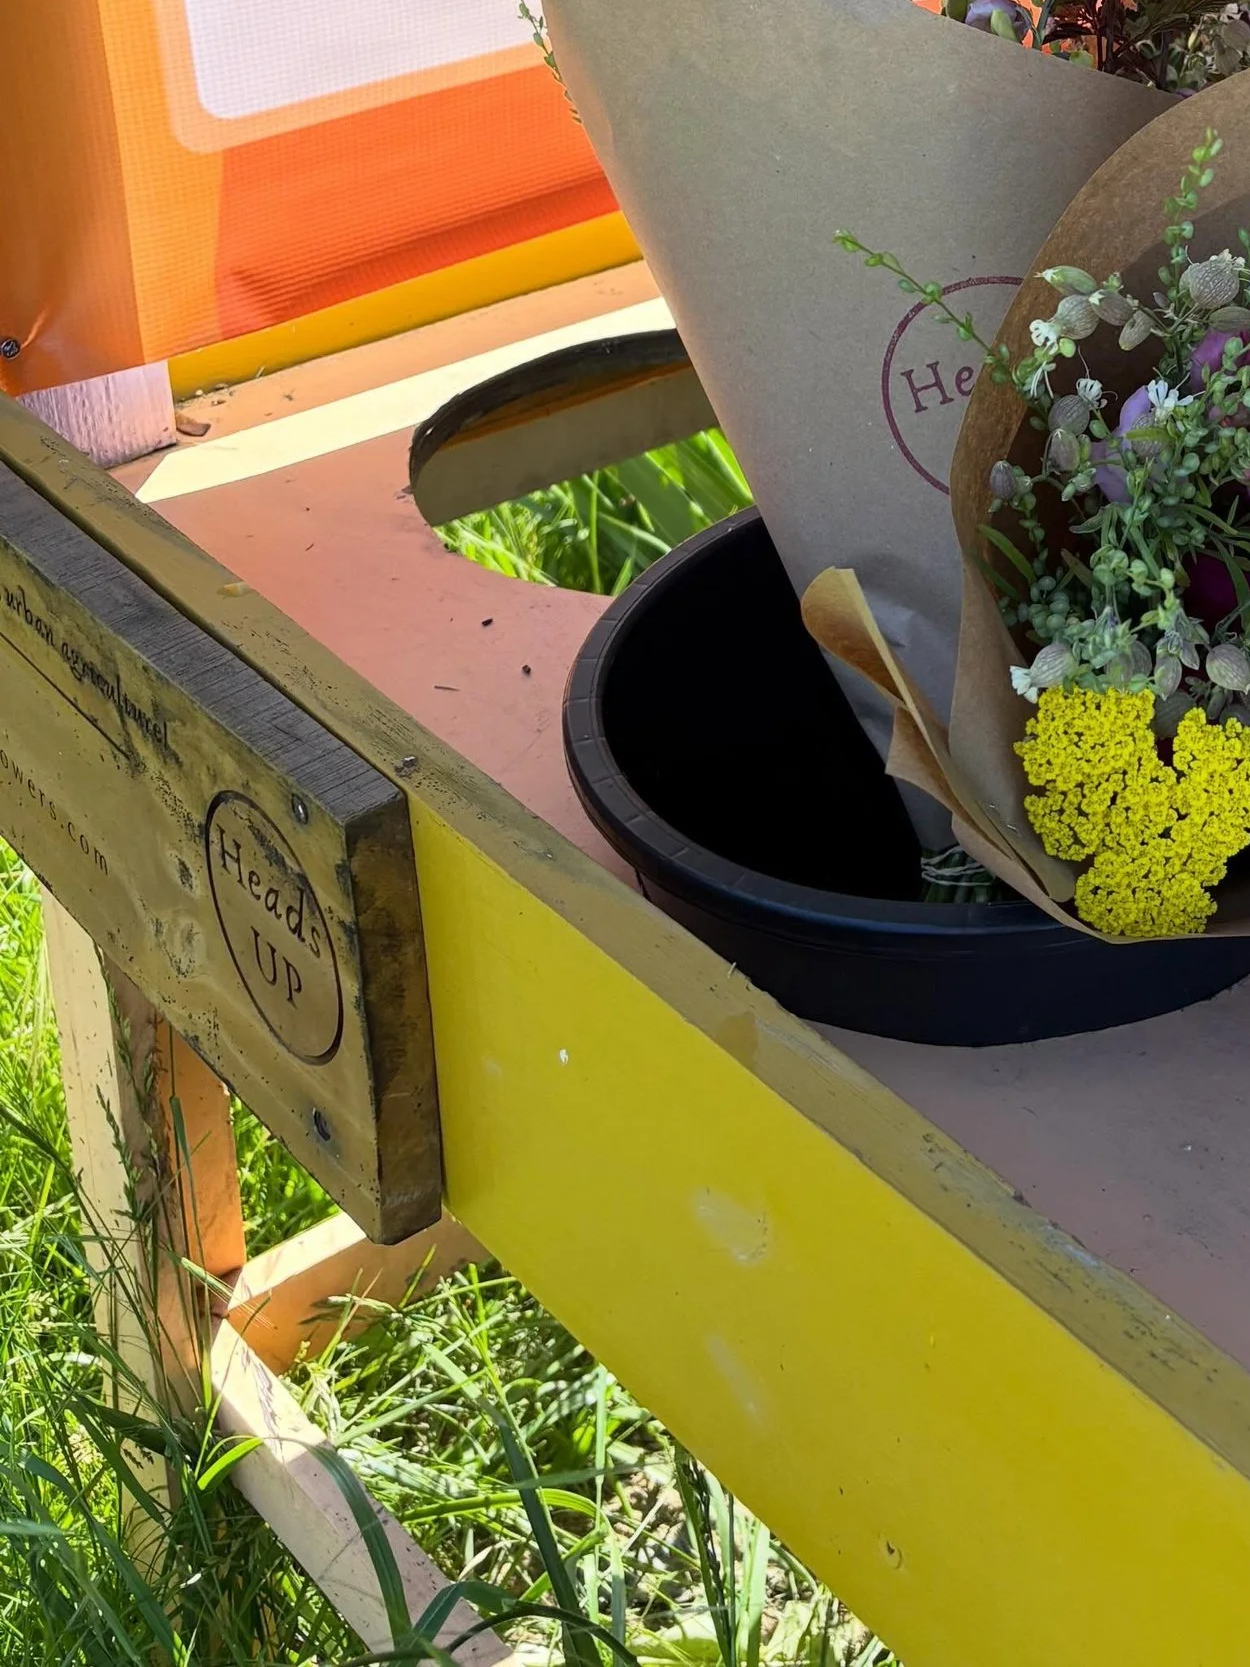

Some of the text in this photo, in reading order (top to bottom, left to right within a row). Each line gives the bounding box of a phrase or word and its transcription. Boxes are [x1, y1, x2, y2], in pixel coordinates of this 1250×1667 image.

[0, 748, 109, 875] owers.com
[215, 821, 322, 959] Heads
[250, 924, 303, 1006] UP
